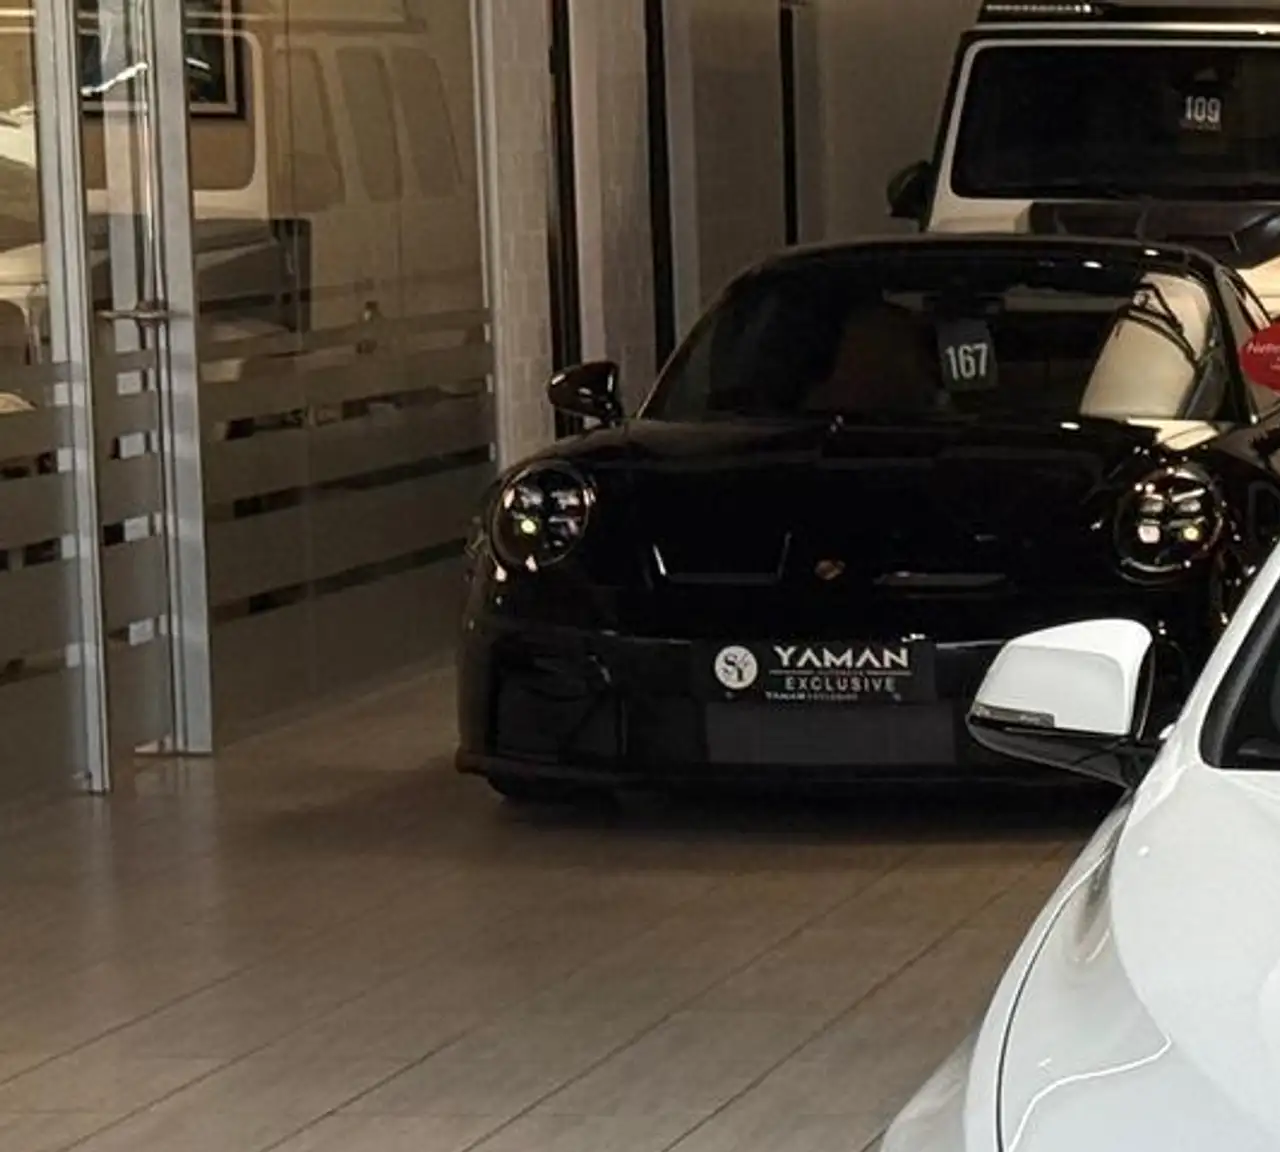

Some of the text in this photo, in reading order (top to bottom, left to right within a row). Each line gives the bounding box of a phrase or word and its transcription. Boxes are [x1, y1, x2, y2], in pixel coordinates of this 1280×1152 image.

[1185, 95, 1221, 123] 109
[944, 342, 988, 381] 167
[773, 645, 909, 669] YAMAN
[785, 676, 897, 693] EXCLUSIVE
